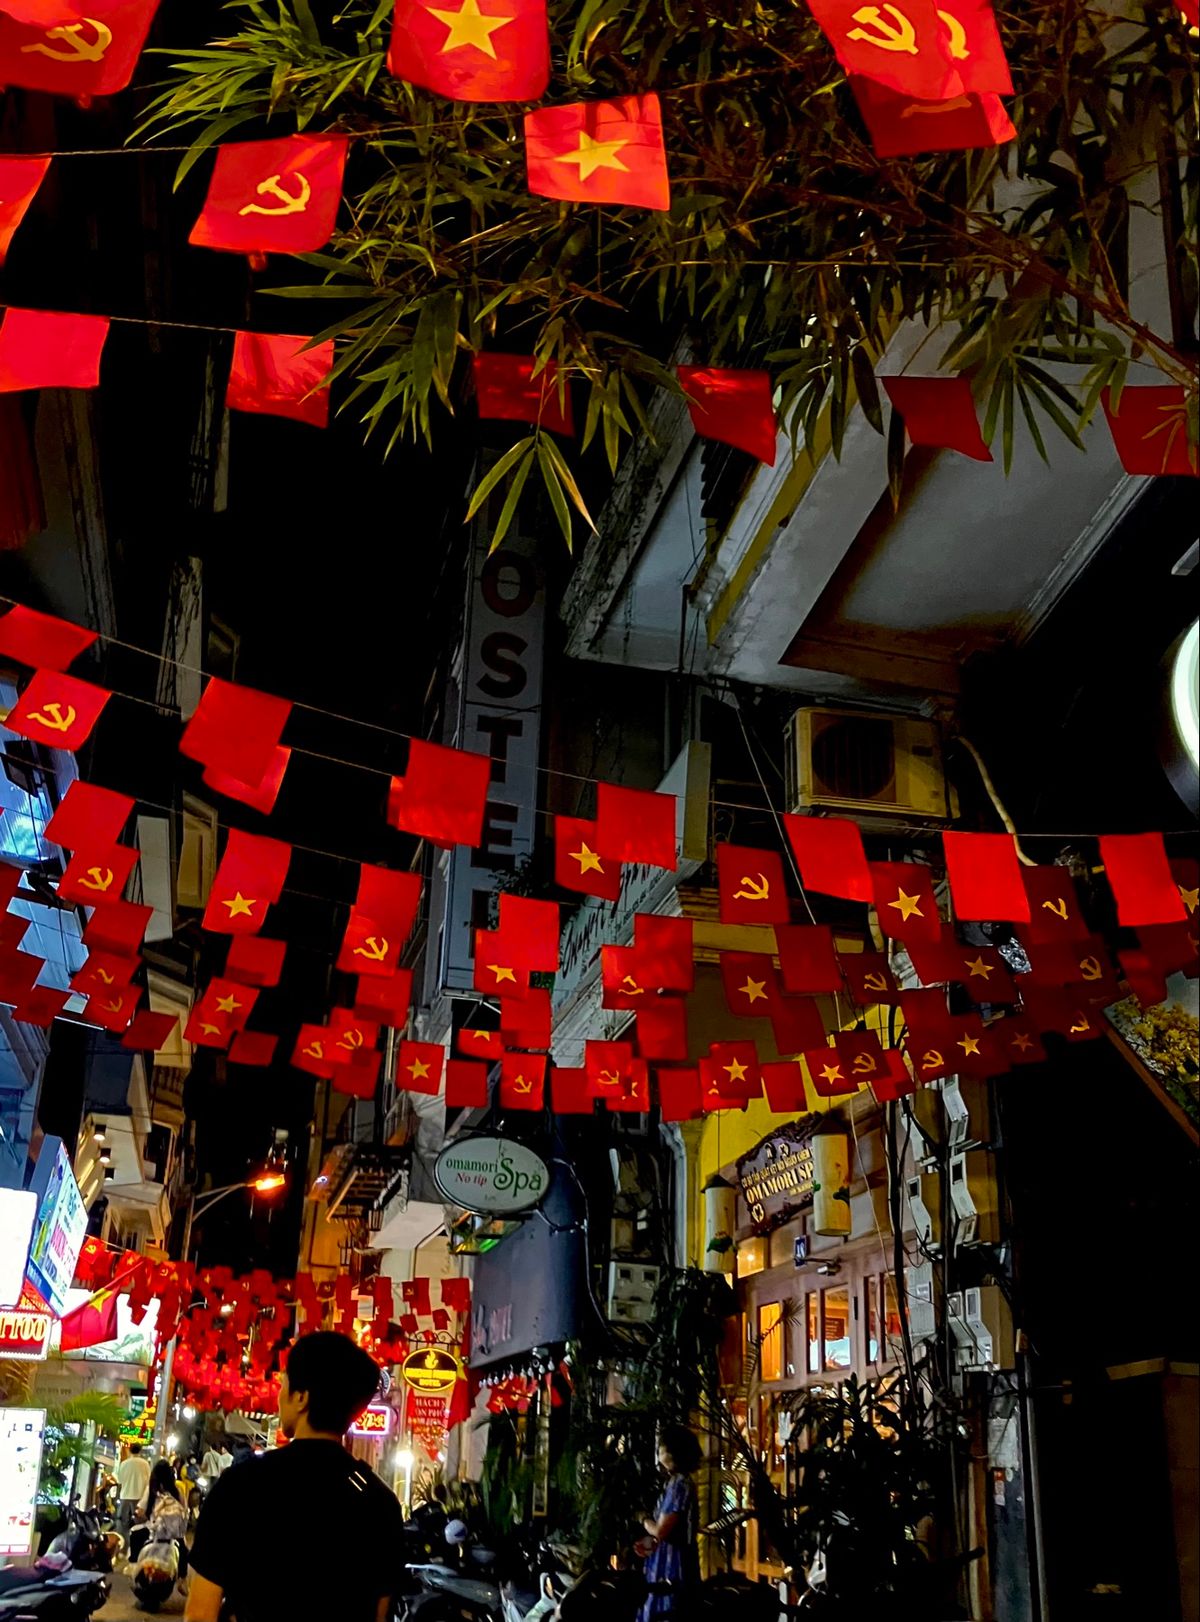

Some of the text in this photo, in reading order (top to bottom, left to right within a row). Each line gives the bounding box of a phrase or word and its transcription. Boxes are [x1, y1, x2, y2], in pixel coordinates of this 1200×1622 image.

[446, 1157, 542, 1197] omamori Spa
[455, 1172, 487, 1187] No tip
[746, 1168, 799, 1204] OMAMORI
[798, 1161, 814, 1180] SP
